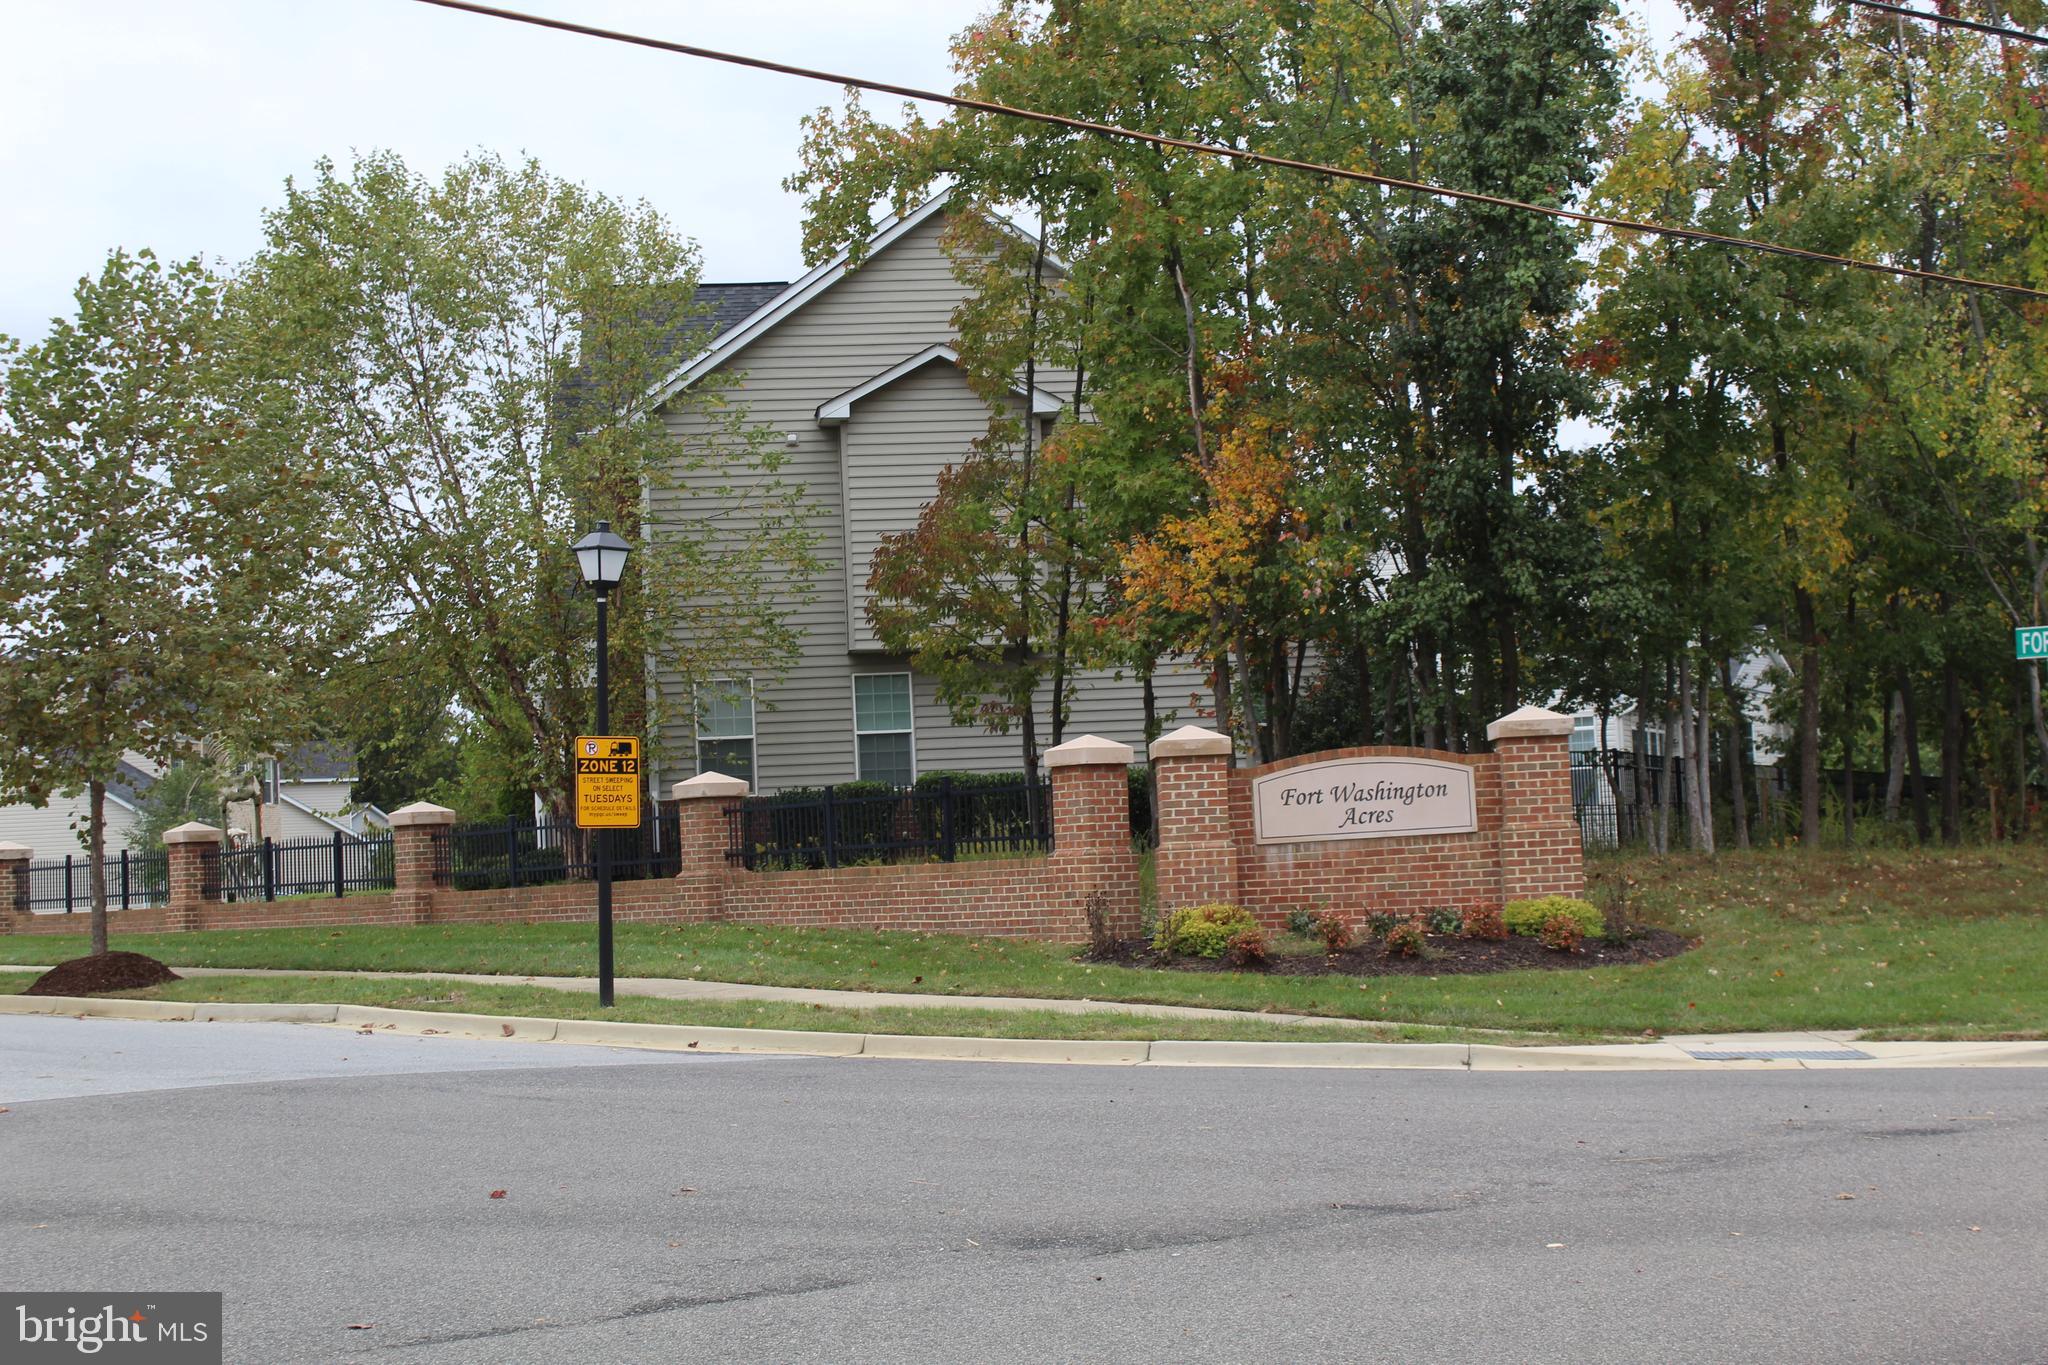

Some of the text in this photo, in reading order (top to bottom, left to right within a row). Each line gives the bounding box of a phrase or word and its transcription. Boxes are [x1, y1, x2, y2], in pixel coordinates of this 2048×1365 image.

[580, 760, 635, 772] ZONE 12
[583, 794, 633, 803] TUESDAYS
[1280, 780, 1448, 806] Fort Washington
[1338, 807, 1394, 828] Acres
